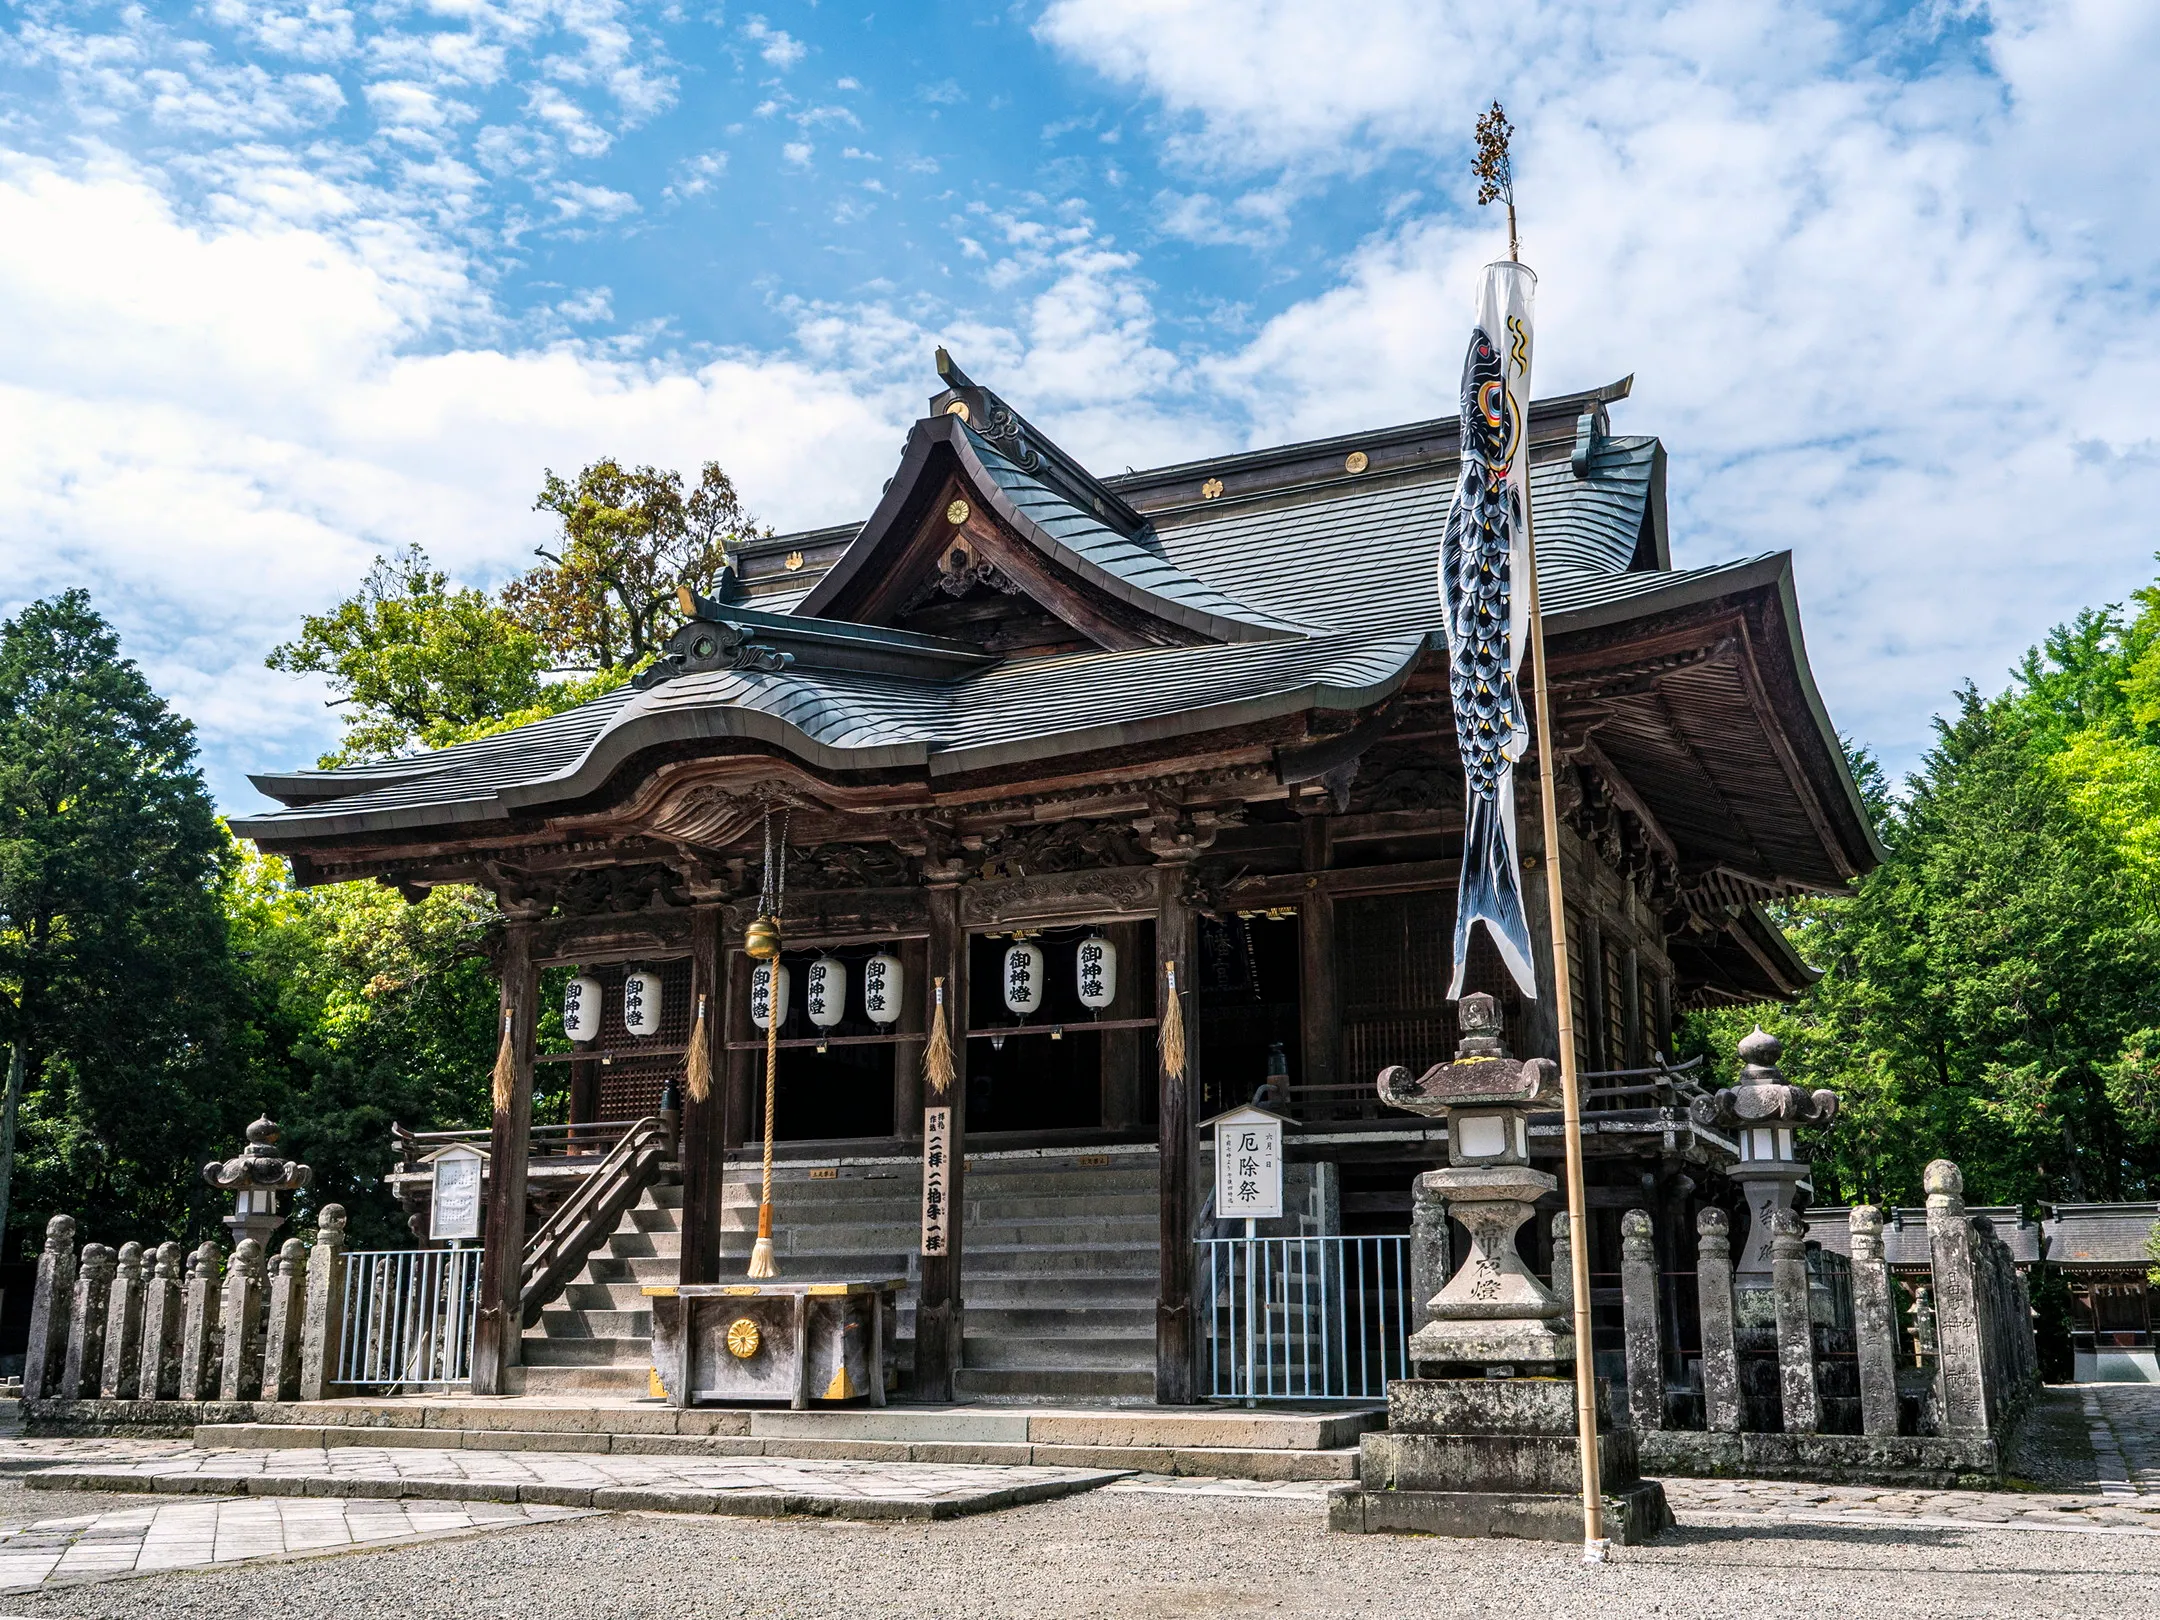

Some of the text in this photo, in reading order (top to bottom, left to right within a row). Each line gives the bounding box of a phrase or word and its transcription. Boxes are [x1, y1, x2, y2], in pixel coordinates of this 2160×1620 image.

[753, 968, 771, 1019] 御神燈
[809, 963, 827, 1015] 御神燈
[867, 960, 887, 1012] 御神燈
[1009, 950, 1032, 1003] 御神燈
[1081, 943, 1104, 997] 御神燈
[564, 982, 583, 1031] 御神燈
[625, 977, 644, 1027] 御神燈
[1237, 1132, 1261, 1203] 厄除祭
[1265, 1132, 1273, 1168] 六月一日
